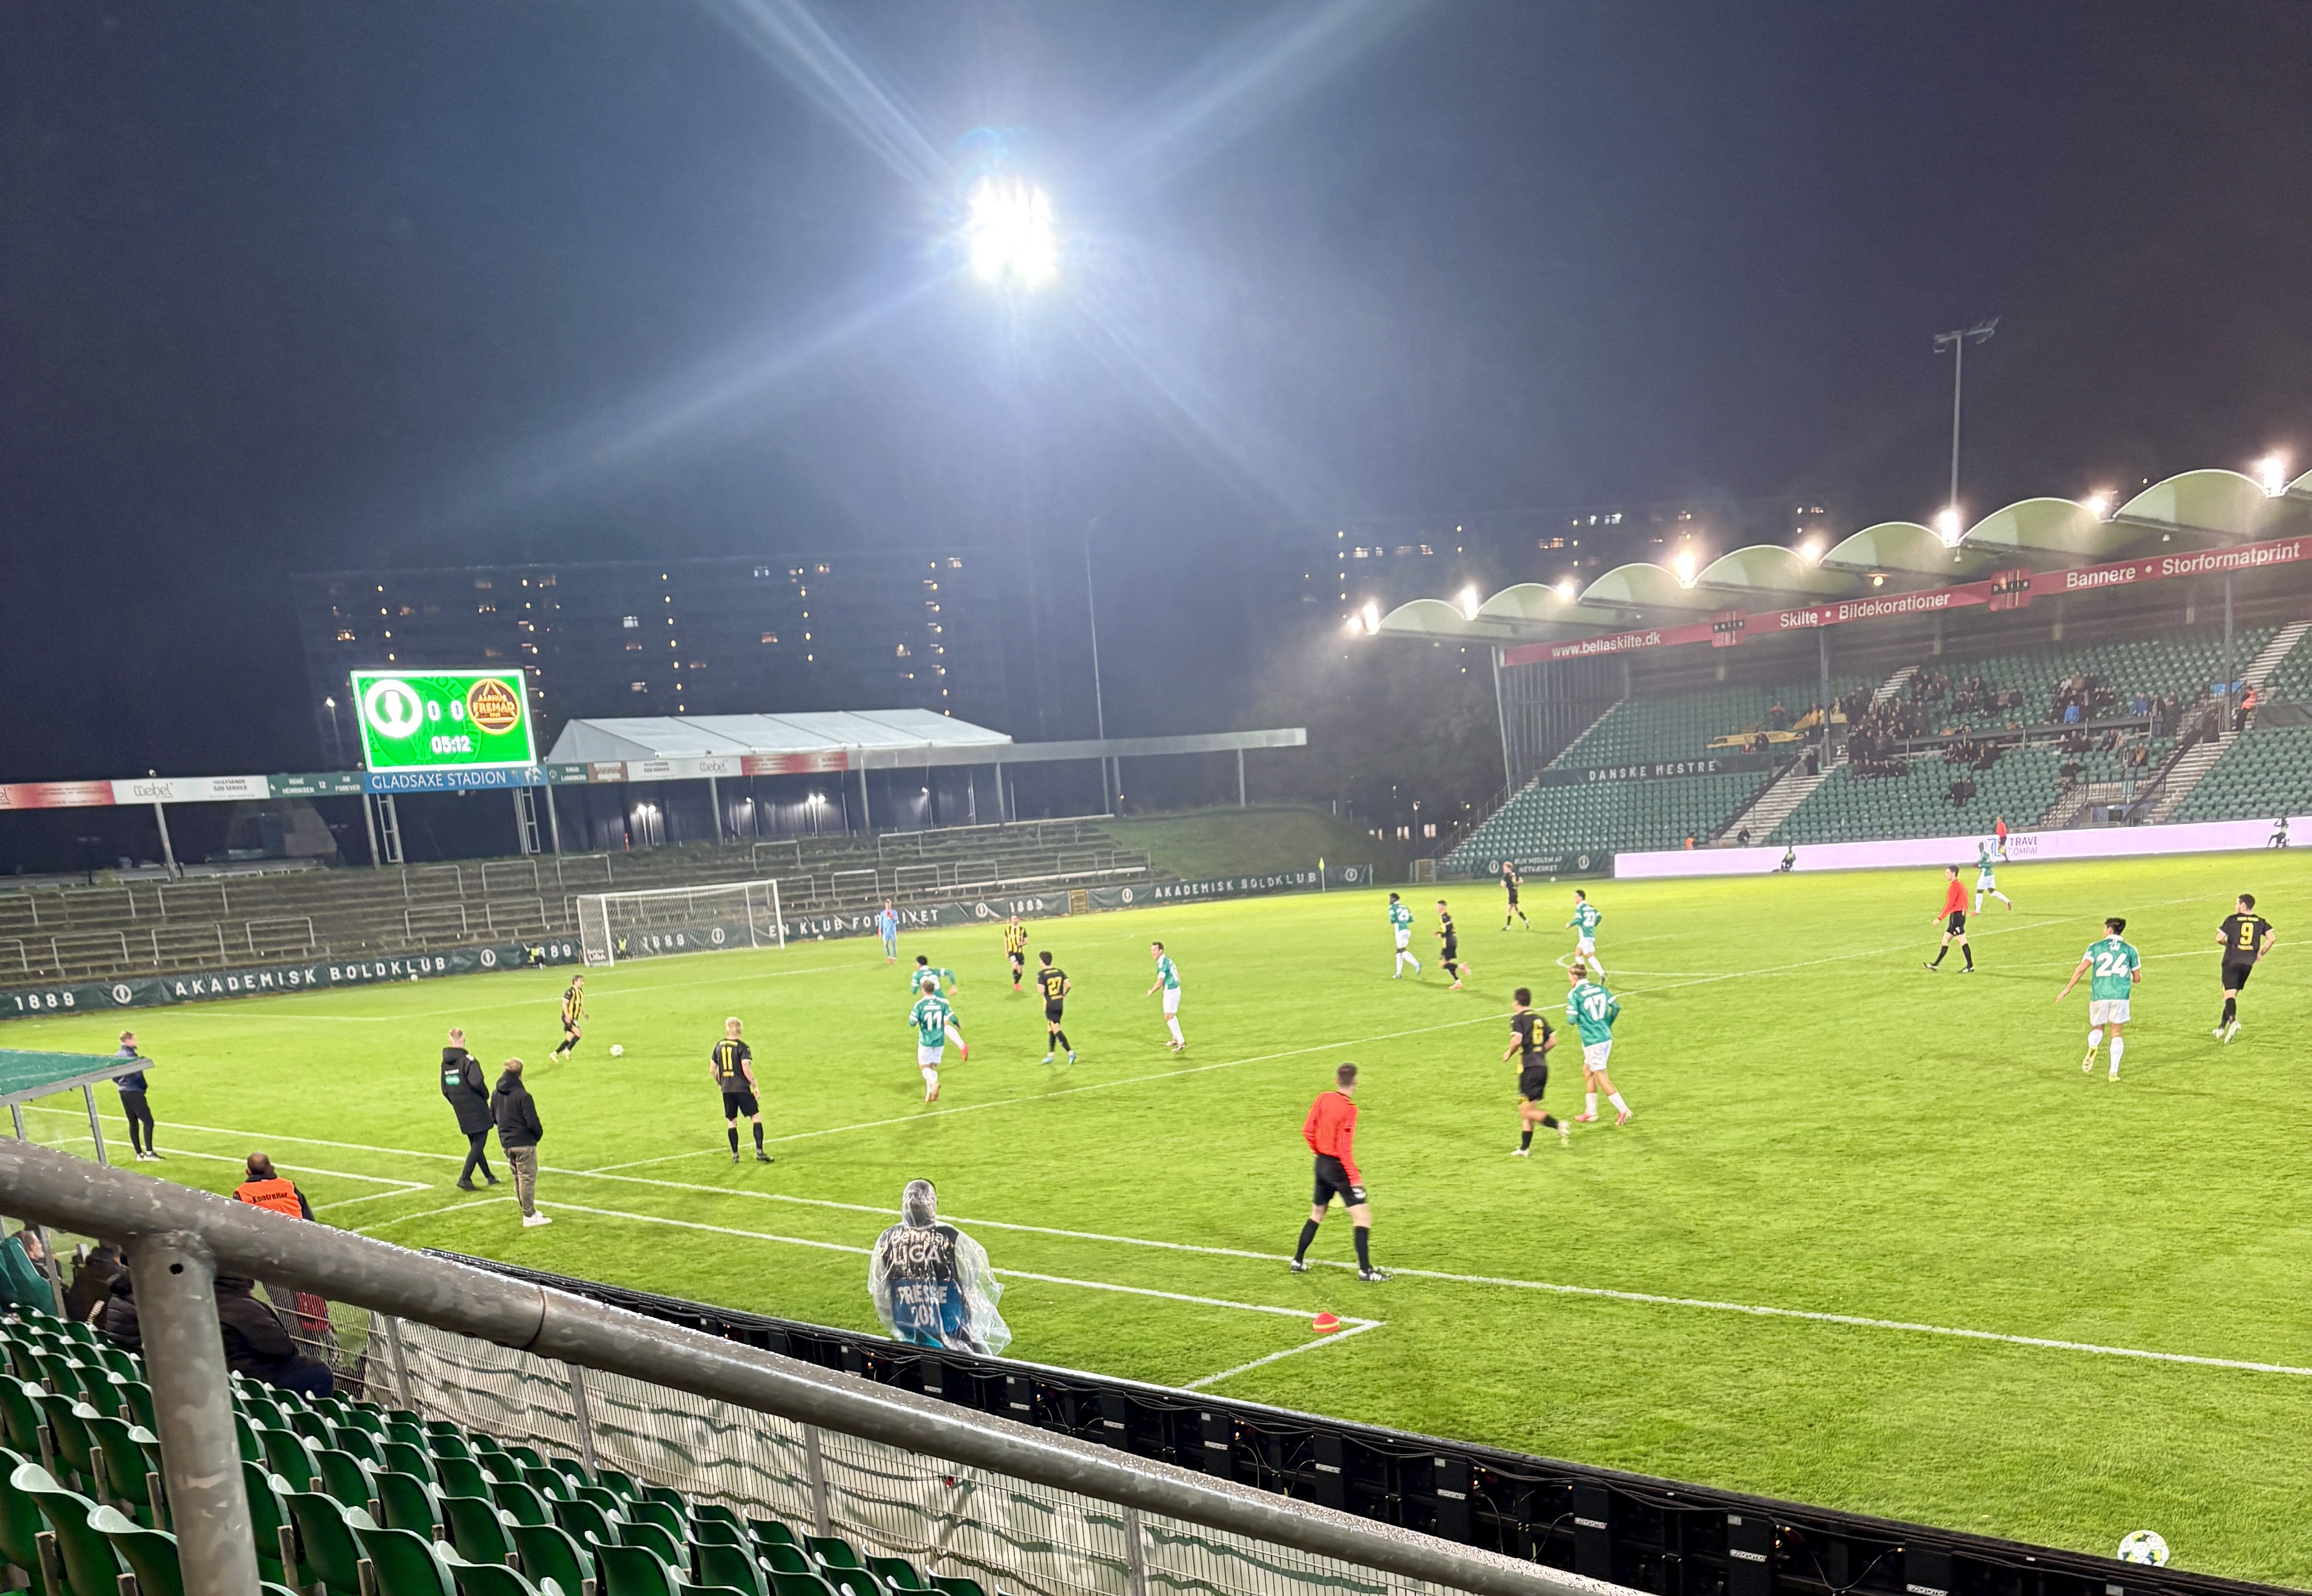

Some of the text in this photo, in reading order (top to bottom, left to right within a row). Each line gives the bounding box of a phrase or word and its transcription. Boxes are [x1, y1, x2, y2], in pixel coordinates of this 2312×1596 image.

[2066, 541, 2300, 588] Bannere Storformatprint
[1780, 593, 1950, 627] Skilte Bildekorationer
[1551, 632, 1661, 658] www.bellaskilte.dk
[427, 700, 464, 721] 0 0
[473, 701, 515, 714] FREMAD
[431, 735, 472, 753] 05:12
[372, 771, 506, 789] GLADSAXE STADION
[1589, 761, 1716, 781] DANSKE MESTRE
[1154, 872, 1317, 898] AKADEMISK BOLDKLUB
[1009, 898, 1044, 914] 1889
[800, 919, 843, 934] KLUB
[902, 909, 938, 923] IVET
[2240, 922, 2254, 944] 9
[2096, 952, 2128, 977] 24
[15, 957, 446, 1010] 1889 AKADEMISK BOLDKLUB
[1047, 976, 1062, 996] 27
[1584, 993, 1606, 1021] 17
[924, 1011, 942, 1031] 11
[721, 1047, 733, 1070] 11
[892, 1243, 941, 1264] LIGA
